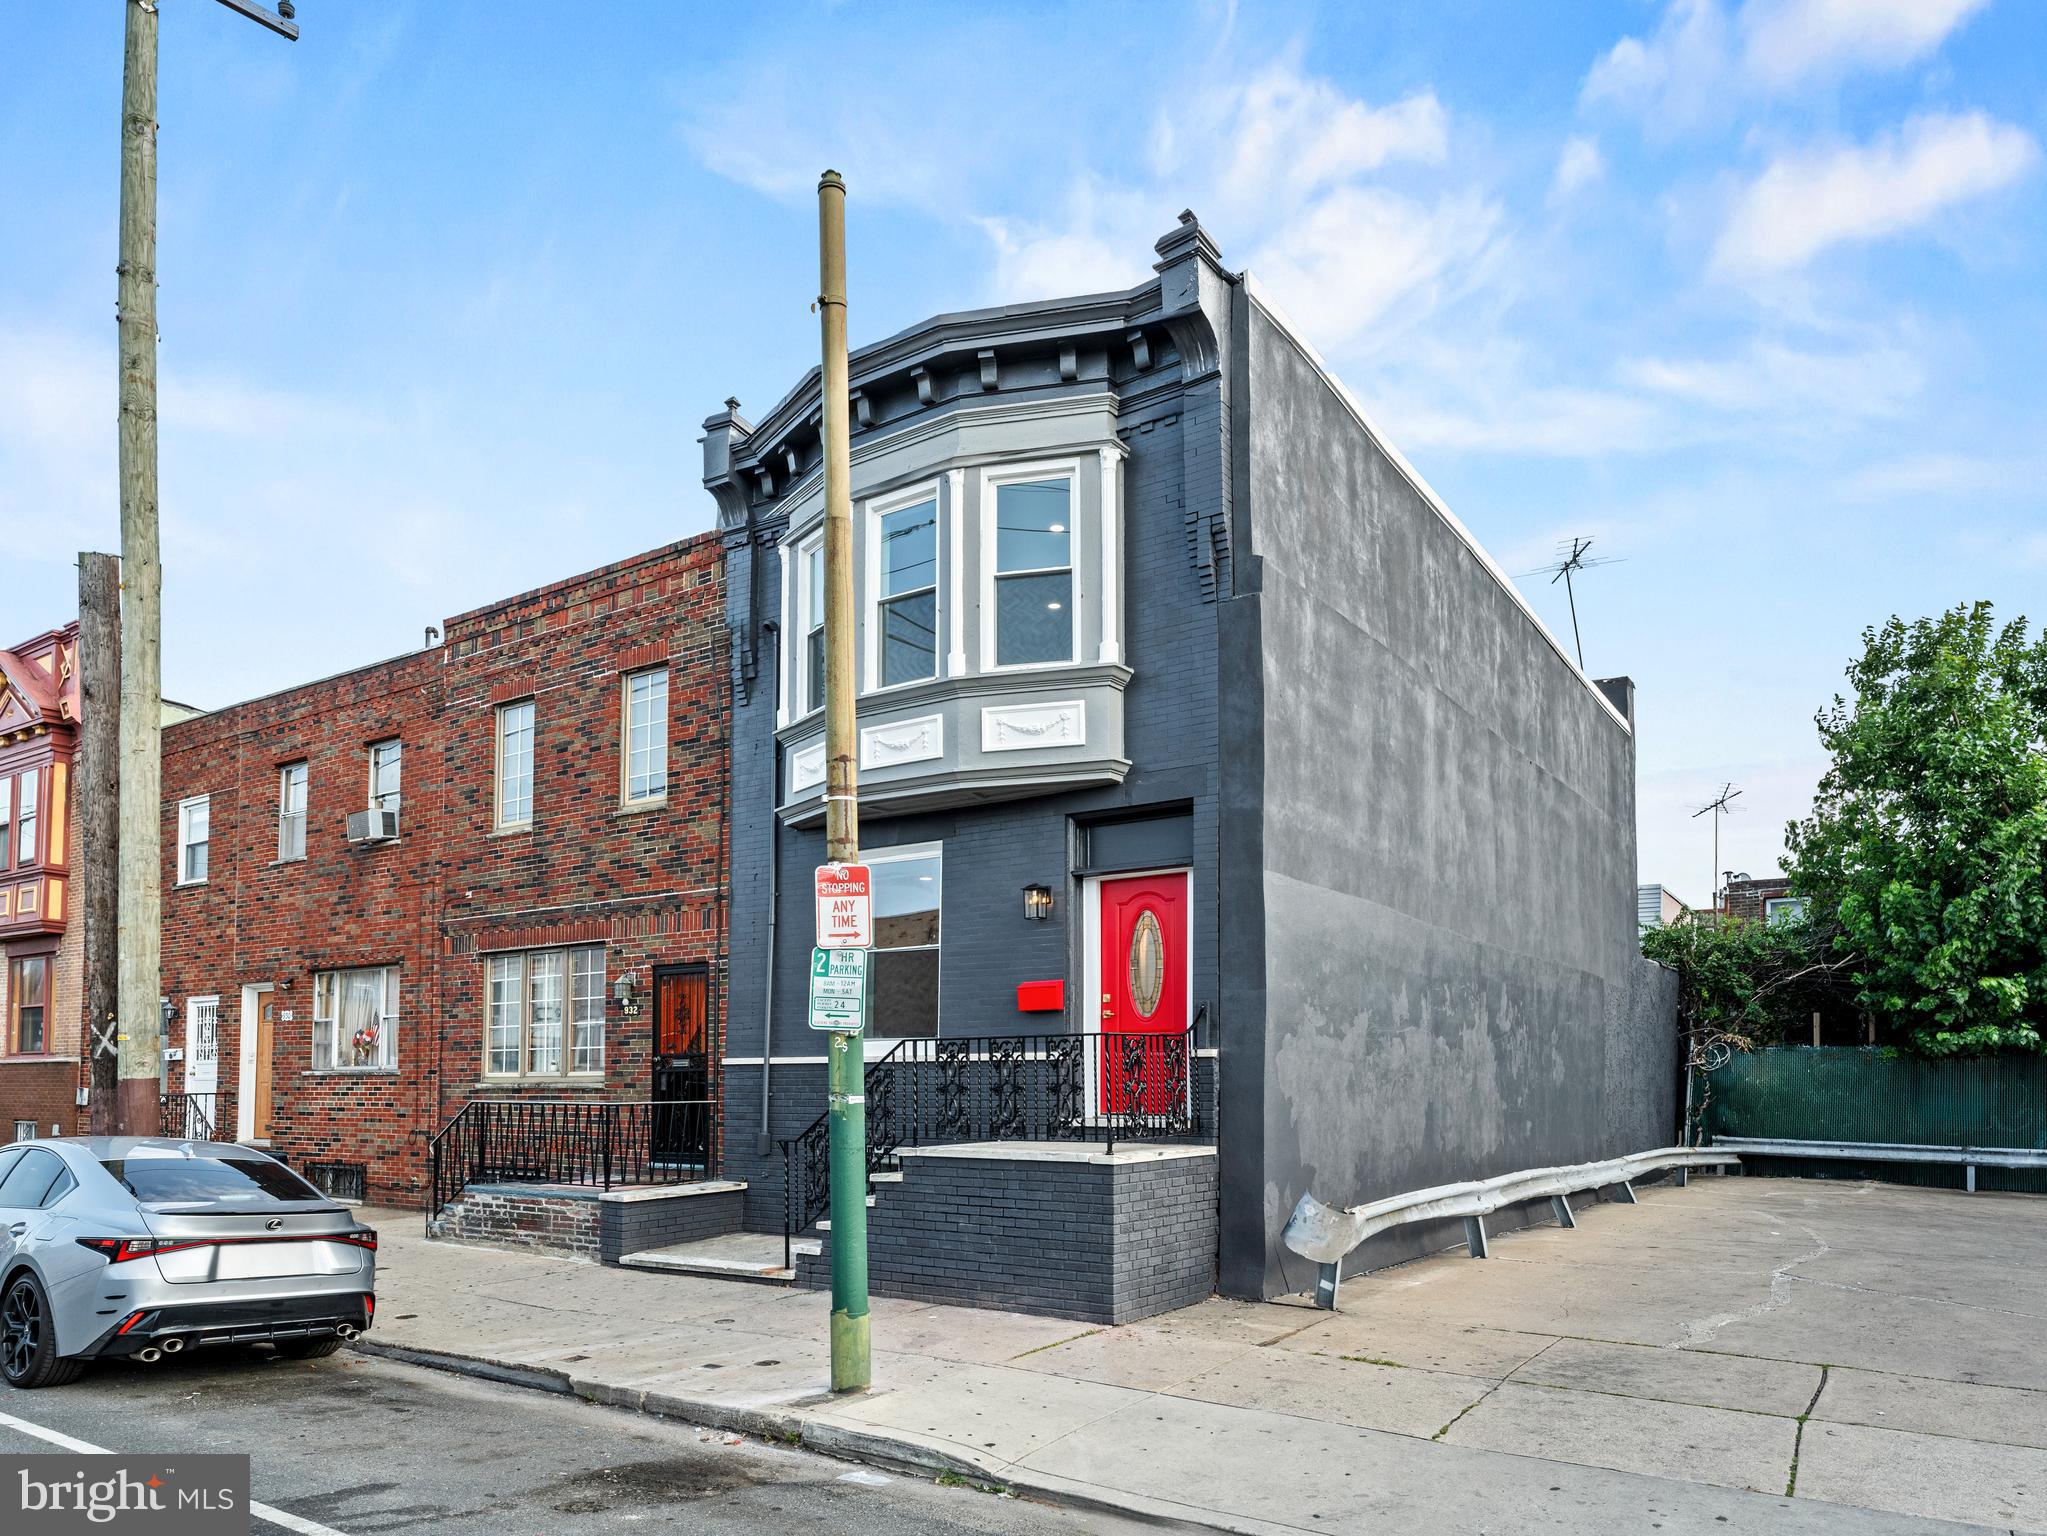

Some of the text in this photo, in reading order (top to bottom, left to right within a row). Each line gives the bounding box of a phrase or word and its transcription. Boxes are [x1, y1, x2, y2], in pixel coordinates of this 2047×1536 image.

[836, 869, 849, 881] NO
[821, 882, 865, 893] STOPPING
[832, 900, 856, 912] ANY
[831, 915, 858, 928] TIME
[816, 952, 855, 973] 2 HR
[830, 964, 863, 976] PARKING
[624, 1006, 638, 1015] 932
